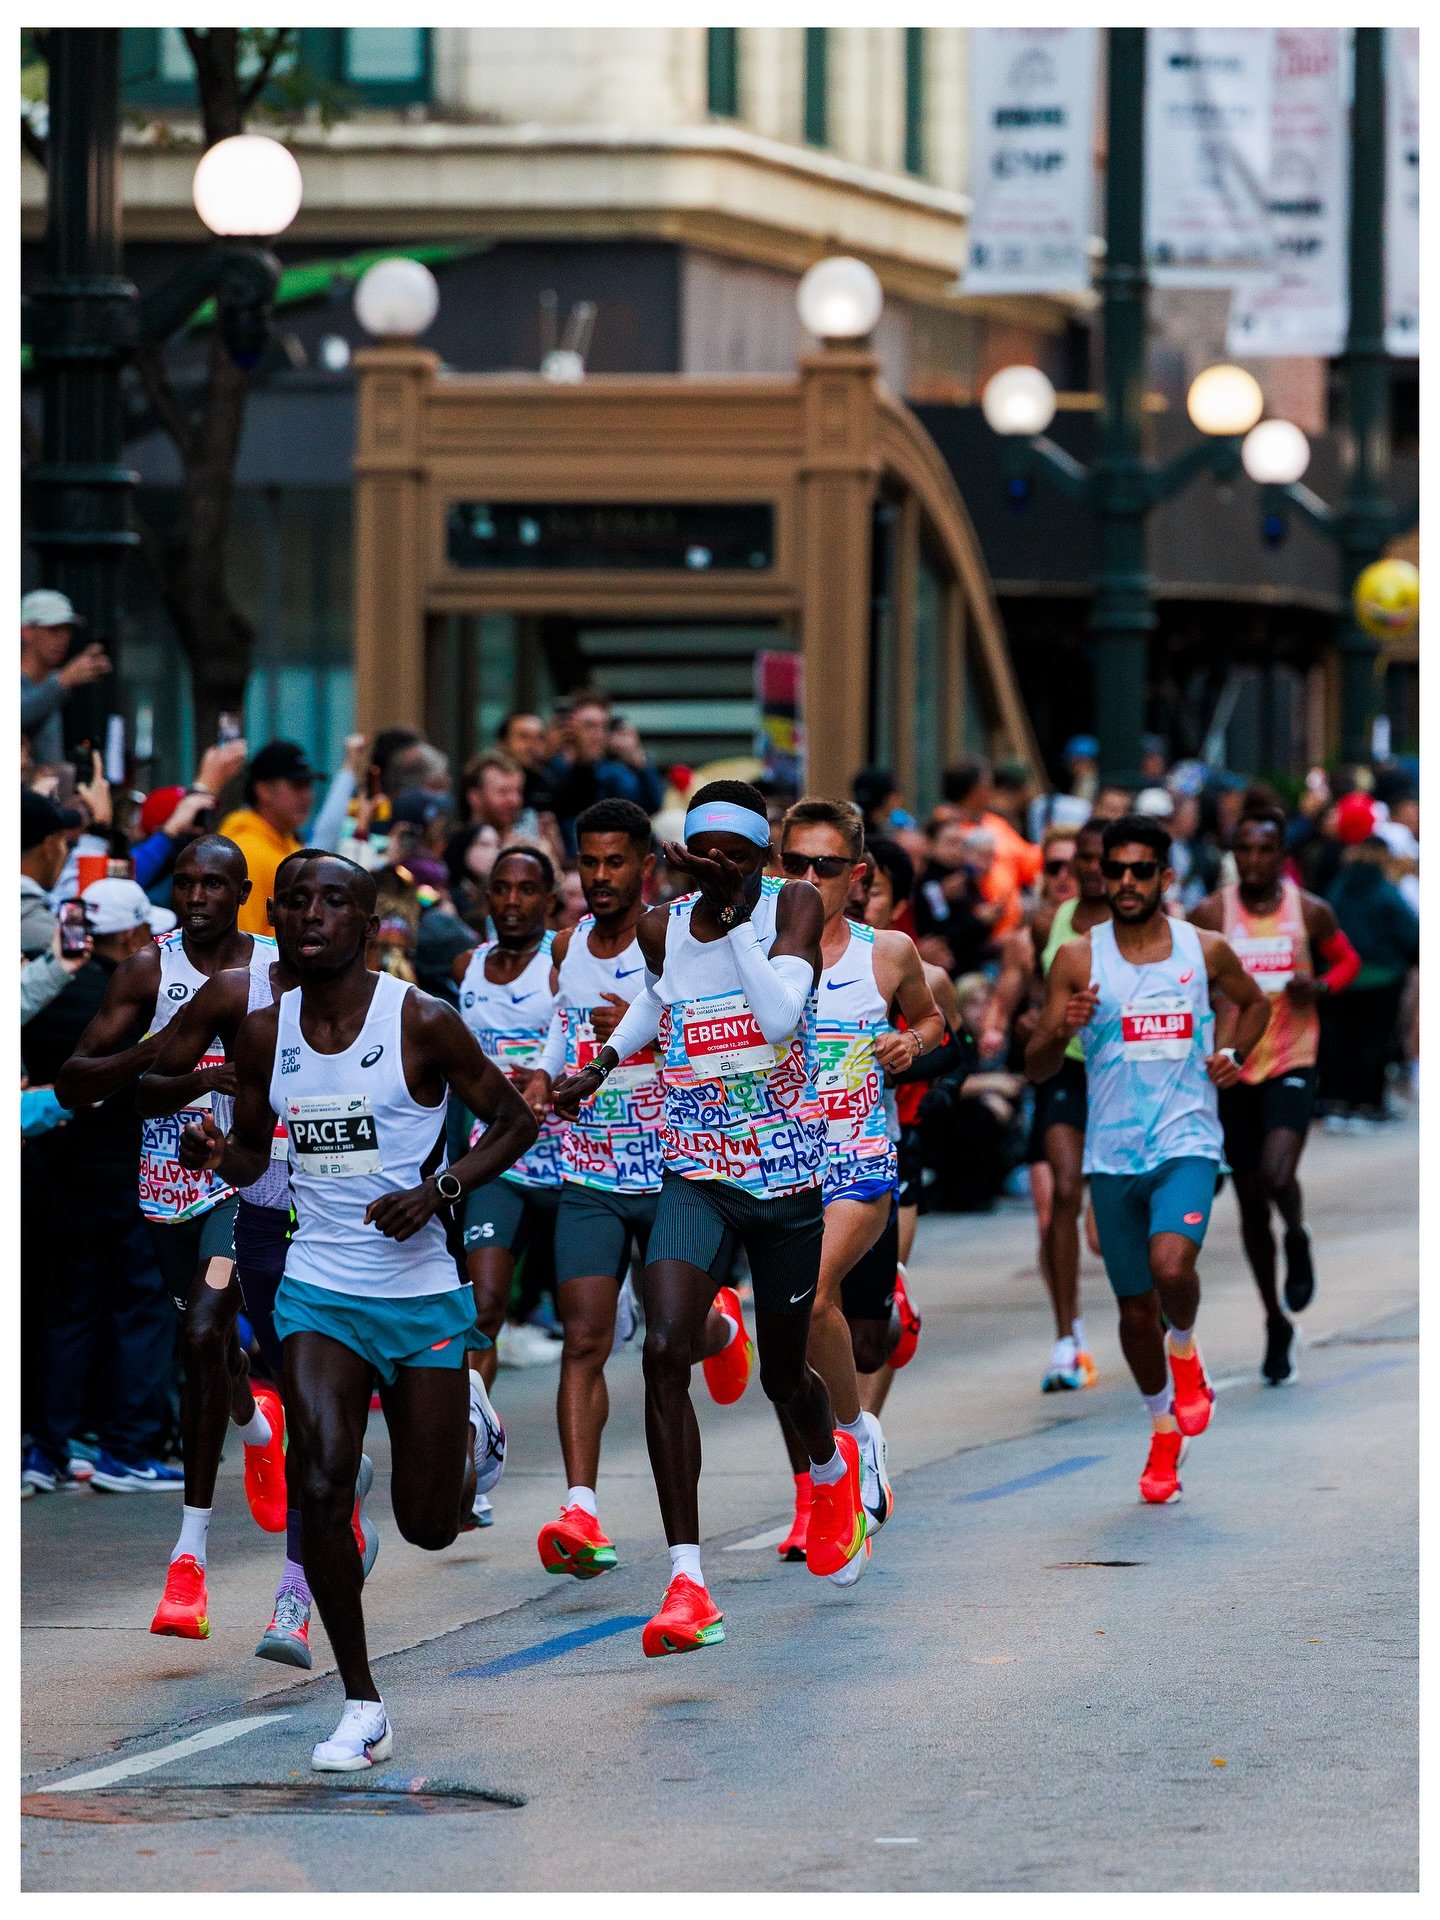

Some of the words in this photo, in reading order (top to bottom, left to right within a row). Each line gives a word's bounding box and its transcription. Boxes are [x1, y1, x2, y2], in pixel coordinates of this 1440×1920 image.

[1130, 1015, 1185, 1034] TALBI
[707, 1043, 729, 1051] OCTOBER
[281, 1064, 301, 1075] CAMP
[293, 1121, 350, 1144] PACE
[356, 1119, 372, 1140] 4
